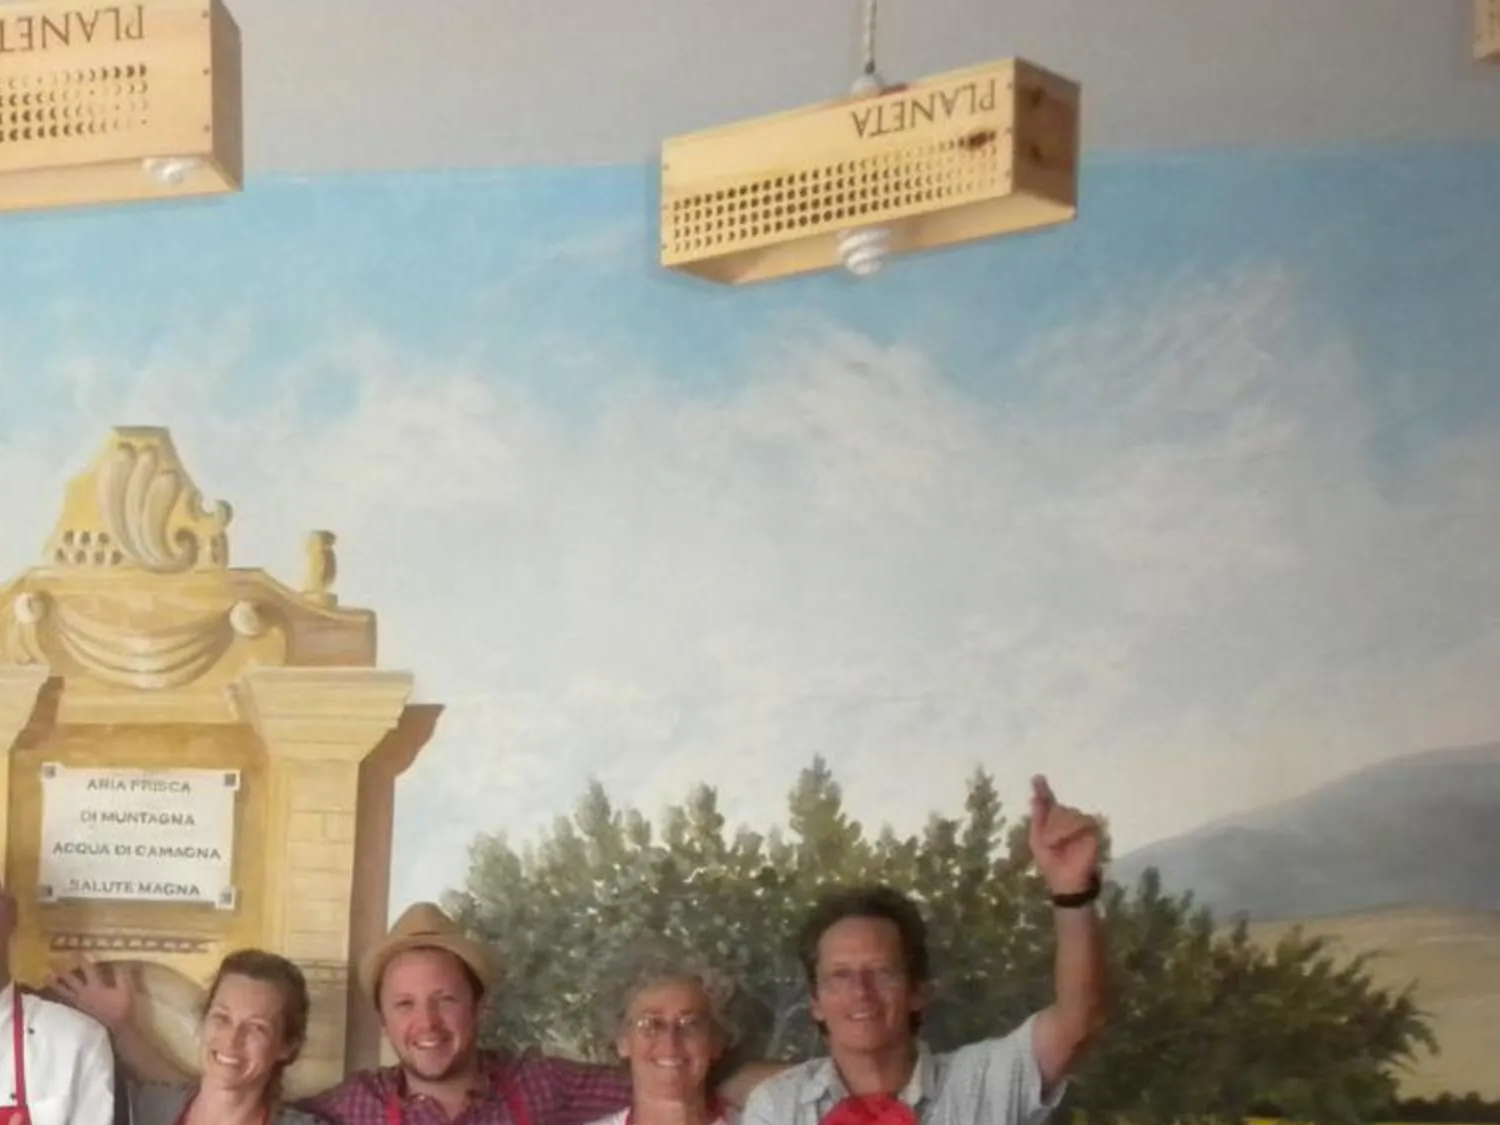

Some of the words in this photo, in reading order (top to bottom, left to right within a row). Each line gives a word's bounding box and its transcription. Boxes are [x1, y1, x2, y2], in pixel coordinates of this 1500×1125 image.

[851, 79, 997, 140] PLANETA
[86, 778, 127, 792] ARIA
[130, 779, 192, 795] FRISCA
[80, 809, 97, 823] DI
[101, 810, 196, 826] MUNTAGNA
[52, 841, 110, 855] ACQUA
[114, 843, 132, 856] DI
[135, 844, 222, 860] CAMAGNA
[68, 878, 133, 893] SALUTE
[138, 880, 200, 897] MAGNA
